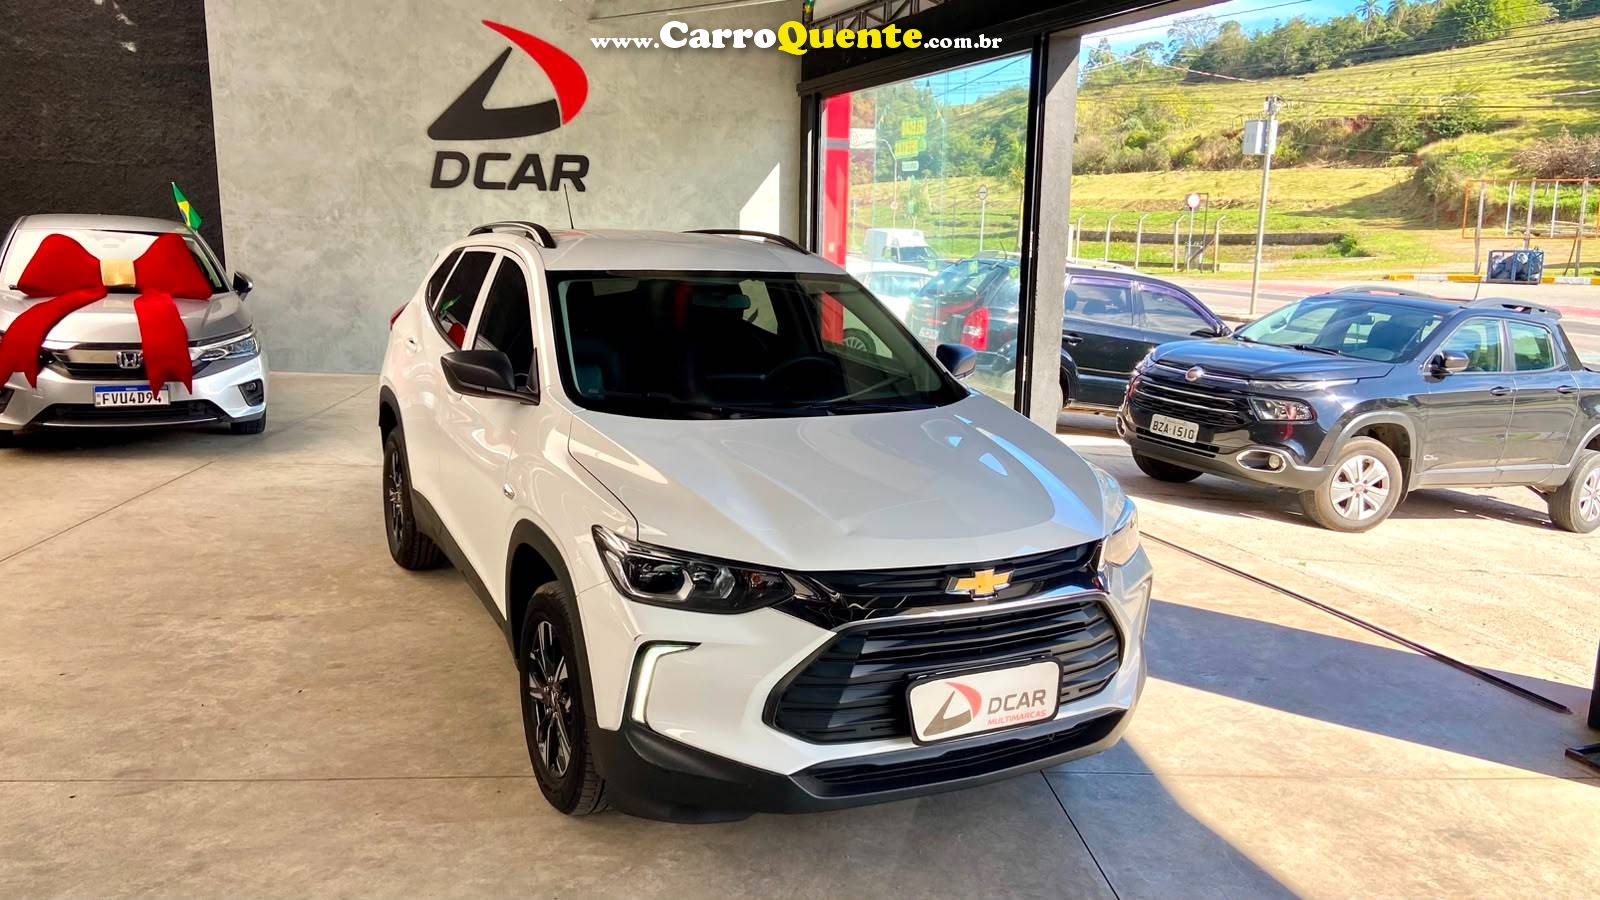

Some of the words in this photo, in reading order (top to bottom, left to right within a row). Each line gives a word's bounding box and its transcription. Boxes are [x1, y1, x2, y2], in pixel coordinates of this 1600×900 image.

[430, 151, 590, 192] DCAR
[987, 689, 1046, 715] DCAR
[986, 709, 1047, 727] MULTIMARCAS
